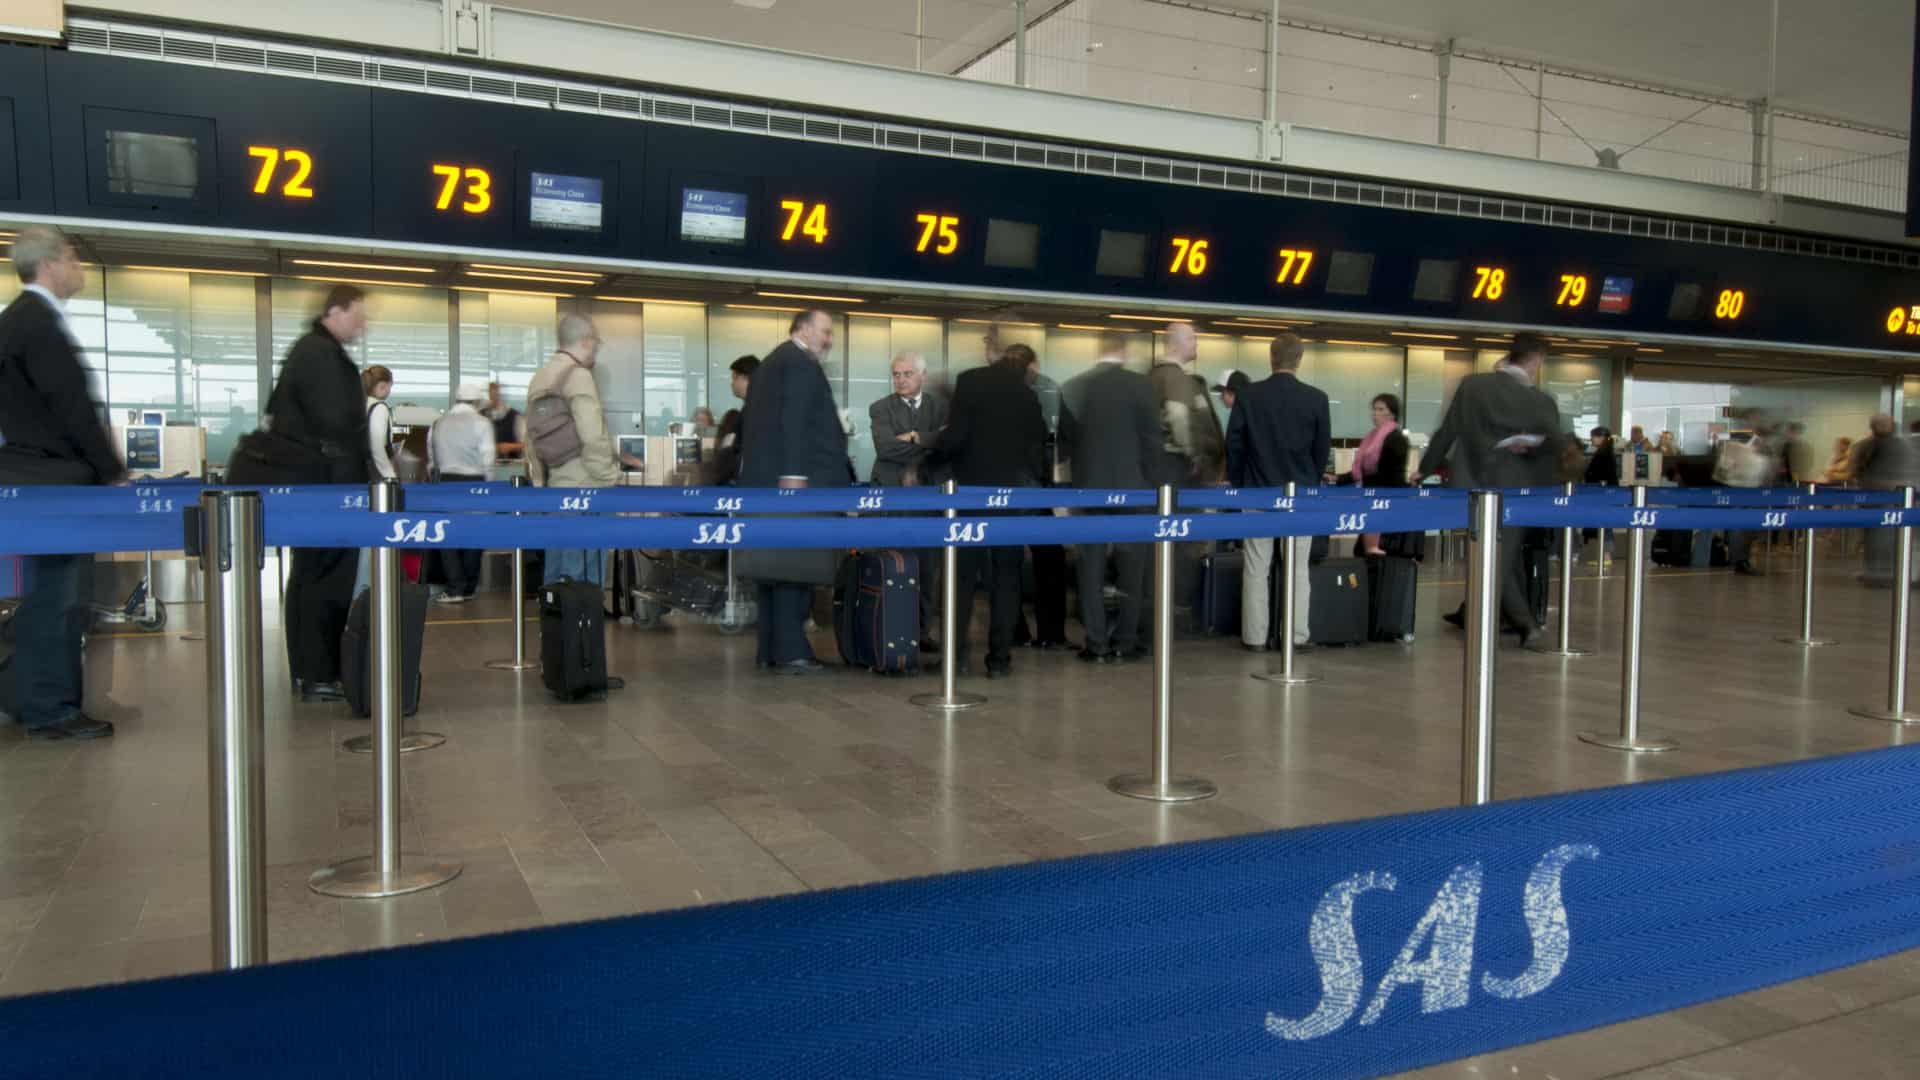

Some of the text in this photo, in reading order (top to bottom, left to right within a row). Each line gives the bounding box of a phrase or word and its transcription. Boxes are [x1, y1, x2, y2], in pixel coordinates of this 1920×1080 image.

[249, 147, 313, 198] 72
[432, 165, 491, 214] 73
[781, 201, 828, 243] 74
[916, 214, 959, 255] 75
[1170, 238, 1208, 275] 76
[1277, 249, 1313, 284] 77
[1472, 267, 1505, 300] 78
[1556, 275, 1587, 307] 79
[1715, 289, 1744, 319] 80
[137, 498, 174, 513] SAS
[340, 495, 369, 508] SA
[559, 497, 591, 510] SAS
[714, 497, 743, 510] SAS
[857, 496, 883, 509] SAS
[986, 495, 1009, 507] SAS
[1105, 494, 1127, 505] SAS
[1273, 496, 1295, 509] SAS
[1371, 499, 1391, 510] SAS
[1154, 518, 1193, 537] SAS
[1335, 513, 1367, 531] SAS
[1630, 510, 1658, 526] SAS
[1761, 512, 1787, 527] SAS
[1880, 511, 1904, 525] SAS
[385, 518, 451, 543] SAS
[692, 523, 745, 544] SAS
[944, 522, 989, 542] SAS
[1265, 843, 1600, 1041] SAS
